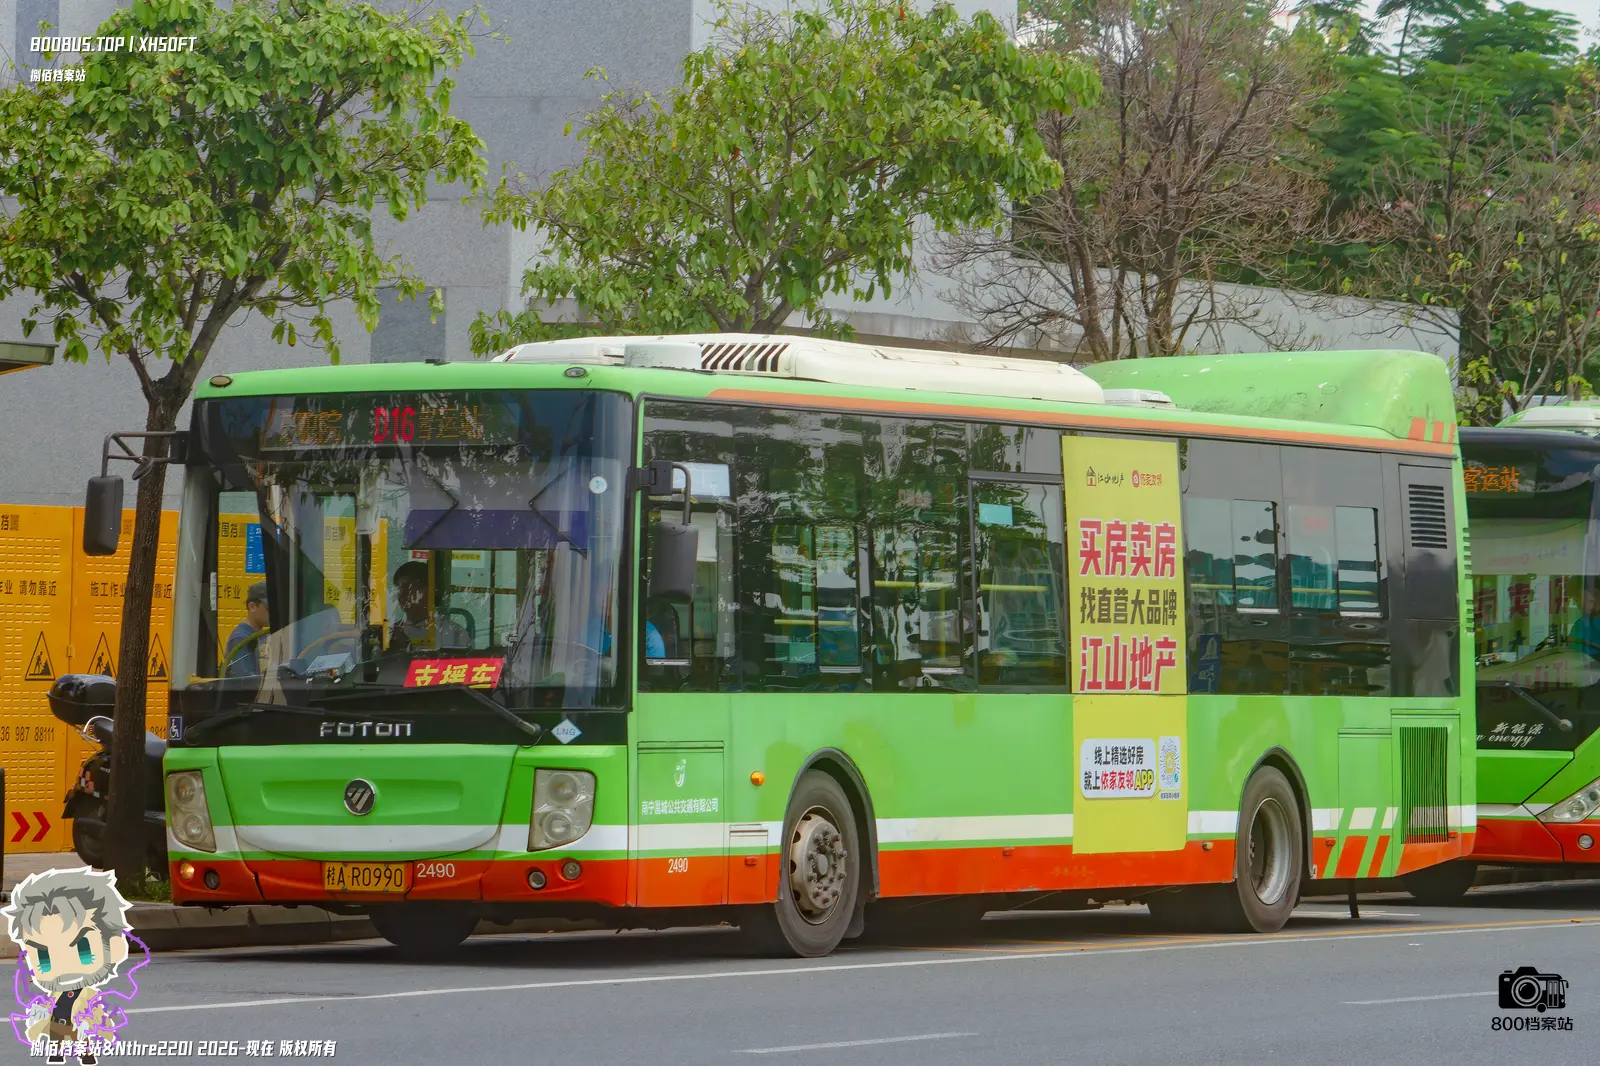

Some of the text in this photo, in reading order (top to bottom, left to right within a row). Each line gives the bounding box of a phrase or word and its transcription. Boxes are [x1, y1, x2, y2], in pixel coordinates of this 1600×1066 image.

[373, 406, 416, 443] D16
[1464, 466, 1520, 493] 客运站
[1079, 519, 1176, 578] 买房卖房
[19, 580, 57, 596] 请勿靠近
[1080, 587, 1177, 625] 找直营大品牌
[1079, 635, 1177, 692] 江山地产
[15, 726, 30, 742] 987
[35, 726, 55, 742] 88111
[319, 722, 412, 737] FOTON
[556, 727, 576, 737] LNG
[1491, 722, 1544, 735] 新能源
[1488, 734, 1535, 748] energy
[1094, 745, 1143, 765] 线上精选好房
[417, 863, 455, 878] 2490
[668, 858, 688, 873] 2490
